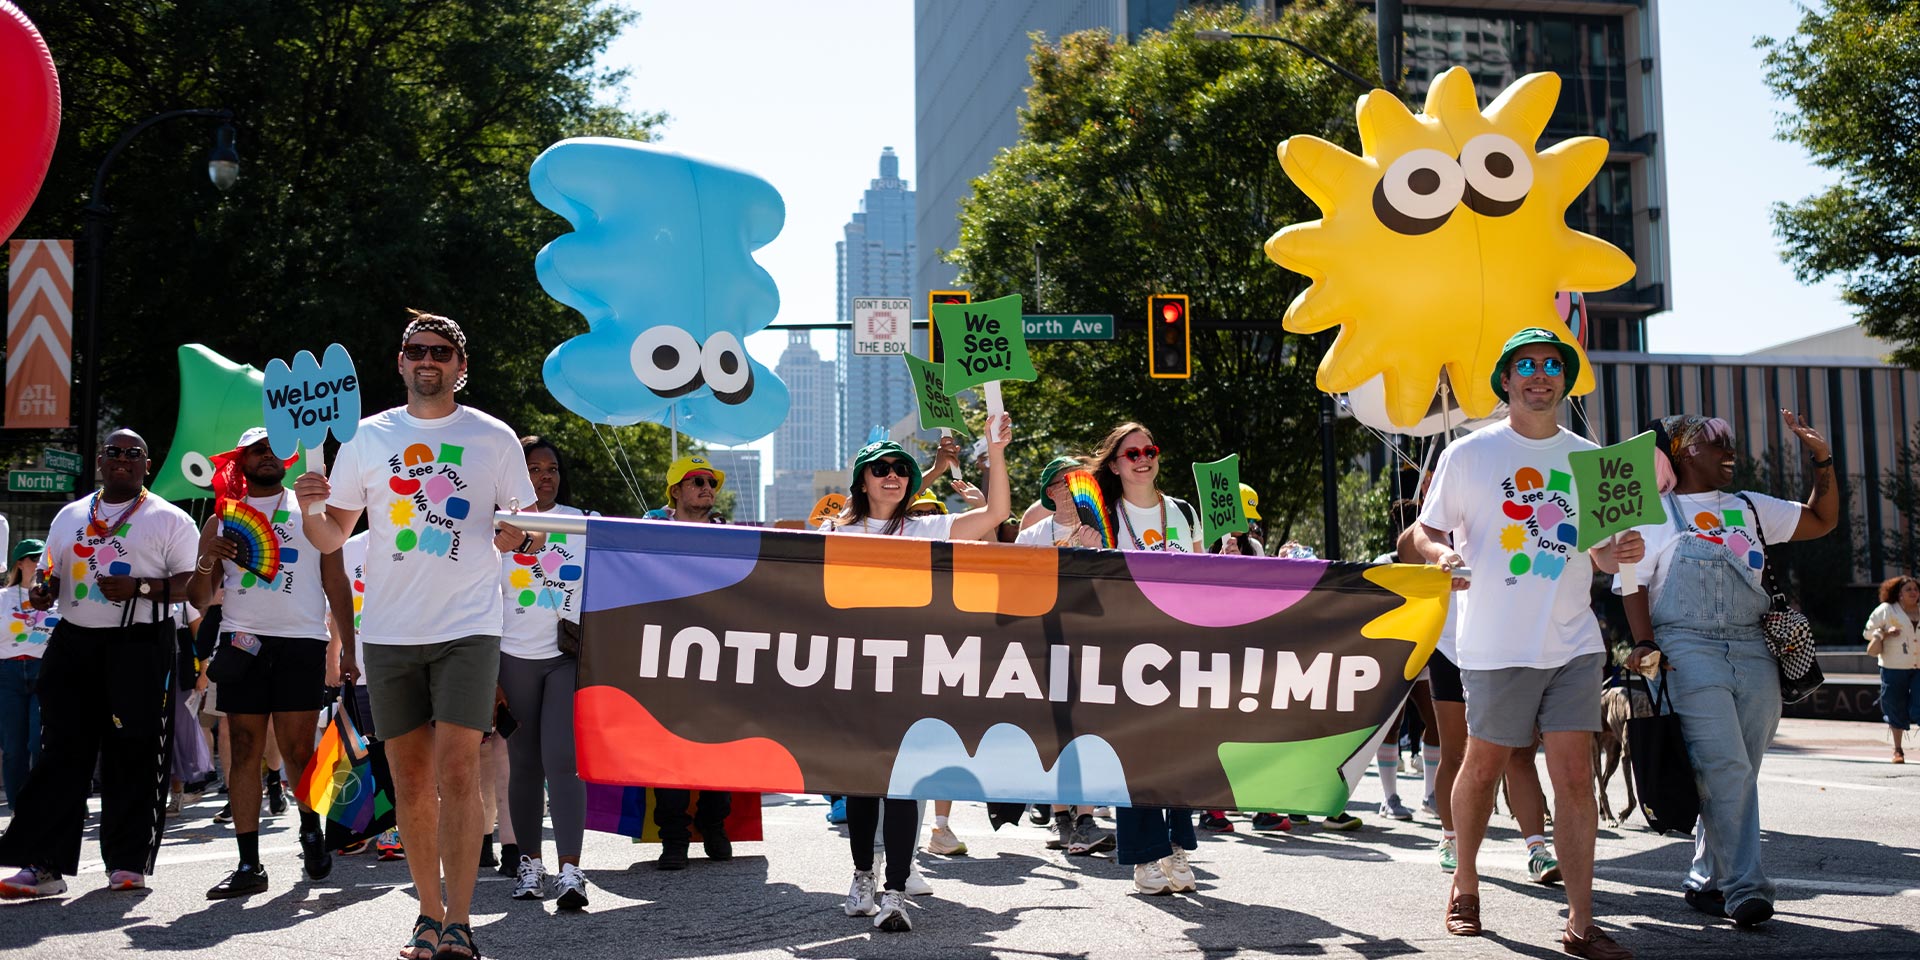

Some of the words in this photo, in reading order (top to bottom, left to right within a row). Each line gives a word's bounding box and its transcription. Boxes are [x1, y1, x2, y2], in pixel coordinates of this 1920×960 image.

[881, 300, 909, 310] BLOCK
[964, 311, 1000, 334] We
[1072, 319, 1103, 334] Ave
[858, 341, 880, 353] THE
[884, 341, 906, 353] BOX
[963, 334, 1009, 353] See
[957, 350, 1012, 377] You!
[922, 365, 944, 391] We
[20, 384, 56, 400] ATL
[925, 384, 951, 407] See
[19, 400, 56, 416] DTN
[288, 396, 340, 429] You!
[925, 400, 955, 423] You!
[388, 453, 402, 474] We
[408, 465, 434, 478] see
[438, 464, 468, 492] you!
[1600, 457, 1634, 480] We
[17, 474, 53, 489] North
[1210, 470, 1229, 491] We
[1598, 480, 1642, 503] See
[1210, 491, 1234, 509] See
[1501, 477, 1515, 499] We
[1521, 491, 1544, 504] see
[1547, 492, 1576, 519] you!
[1208, 506, 1237, 530] You!
[1592, 495, 1644, 529] You!
[273, 524, 293, 543] you!
[413, 489, 428, 512] We
[425, 510, 454, 529] love
[448, 530, 461, 562] you!
[1525, 515, 1539, 537] We
[1537, 536, 1567, 554] love
[1733, 526, 1756, 546] you!
[75, 526, 85, 542] We
[88, 537, 106, 546] see
[108, 536, 128, 558] you!
[550, 543, 575, 561] you!
[88, 554, 98, 571] We
[282, 571, 294, 594] you!
[531, 563, 543, 579] We
[542, 577, 566, 589] love
[562, 588, 575, 612] you!
